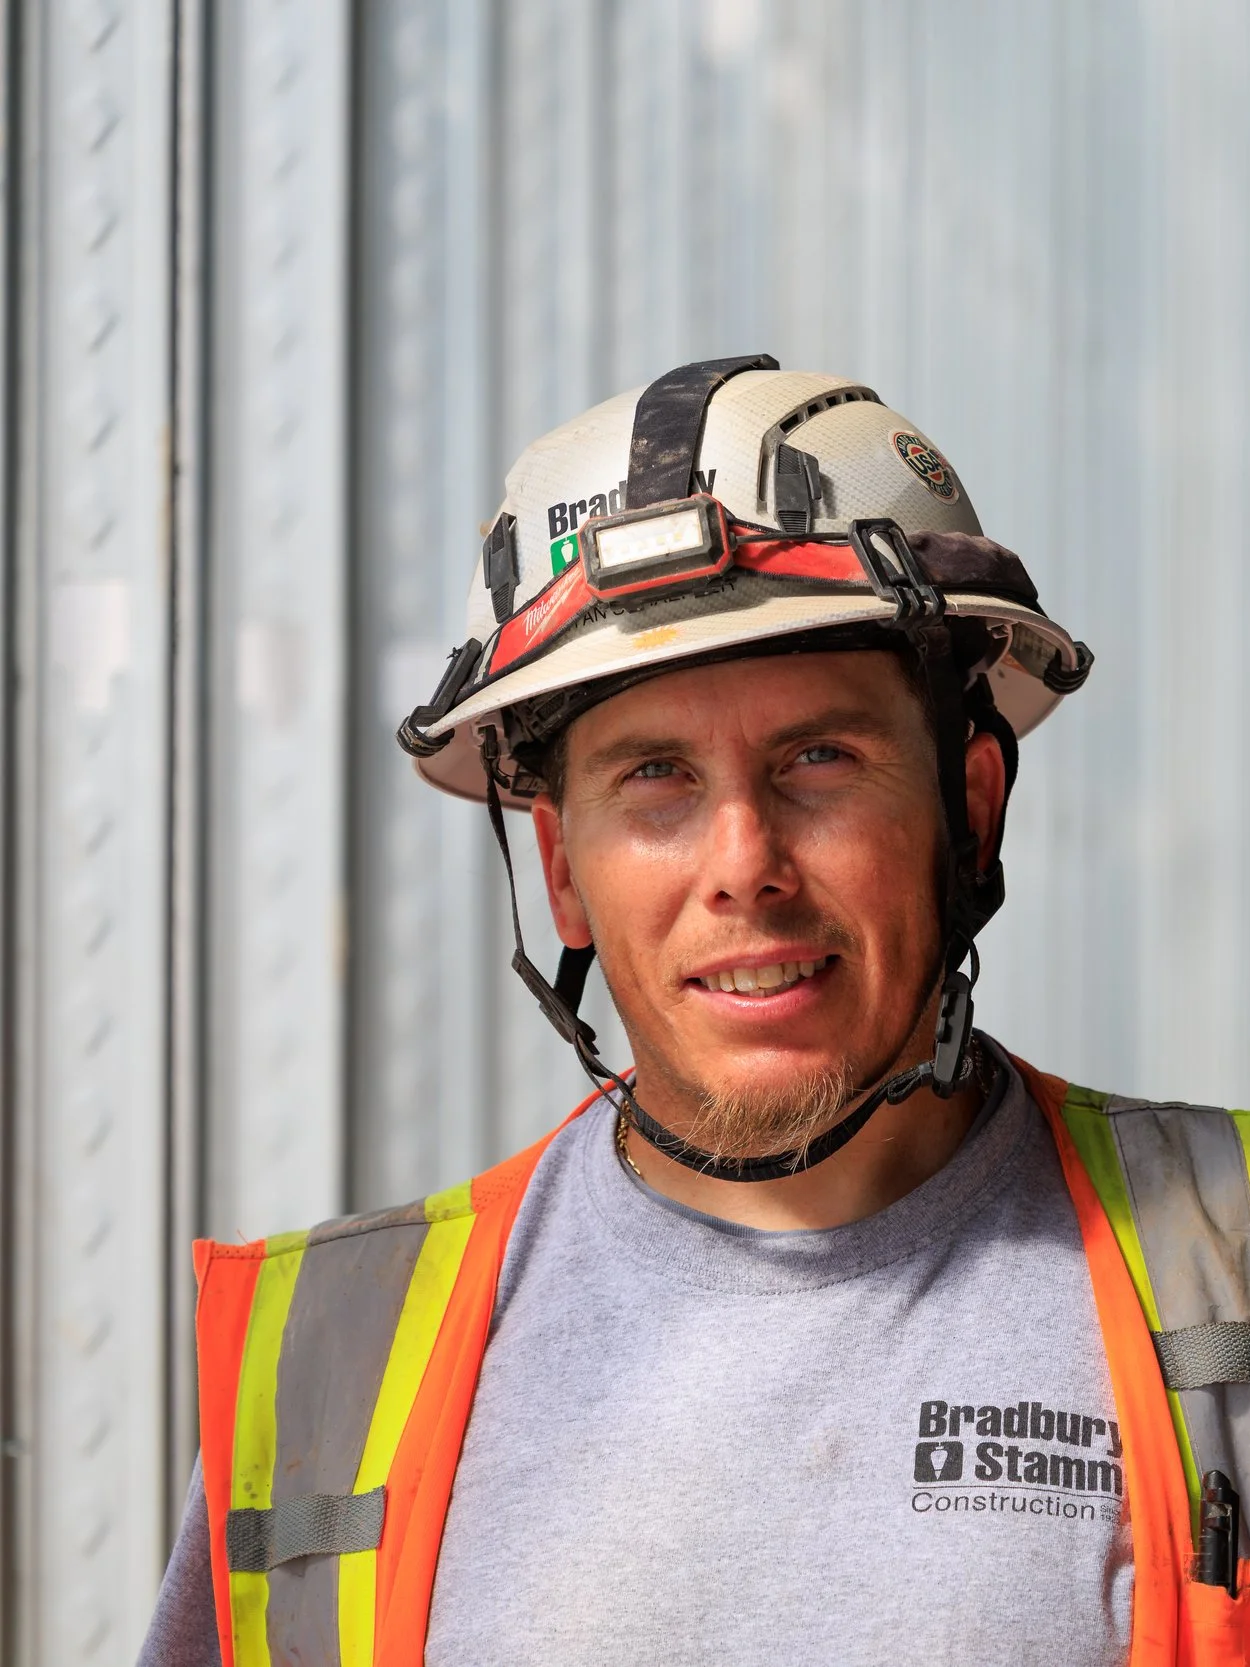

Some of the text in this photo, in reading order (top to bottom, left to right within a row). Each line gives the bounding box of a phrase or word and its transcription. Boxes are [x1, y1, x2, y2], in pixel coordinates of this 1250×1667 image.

[906, 449, 945, 476] USA
[547, 469, 717, 540] Brady
[918, 1400, 1123, 1459] Bradbury
[975, 1441, 1123, 1496] Stamm
[911, 1491, 1096, 1521] Construction
